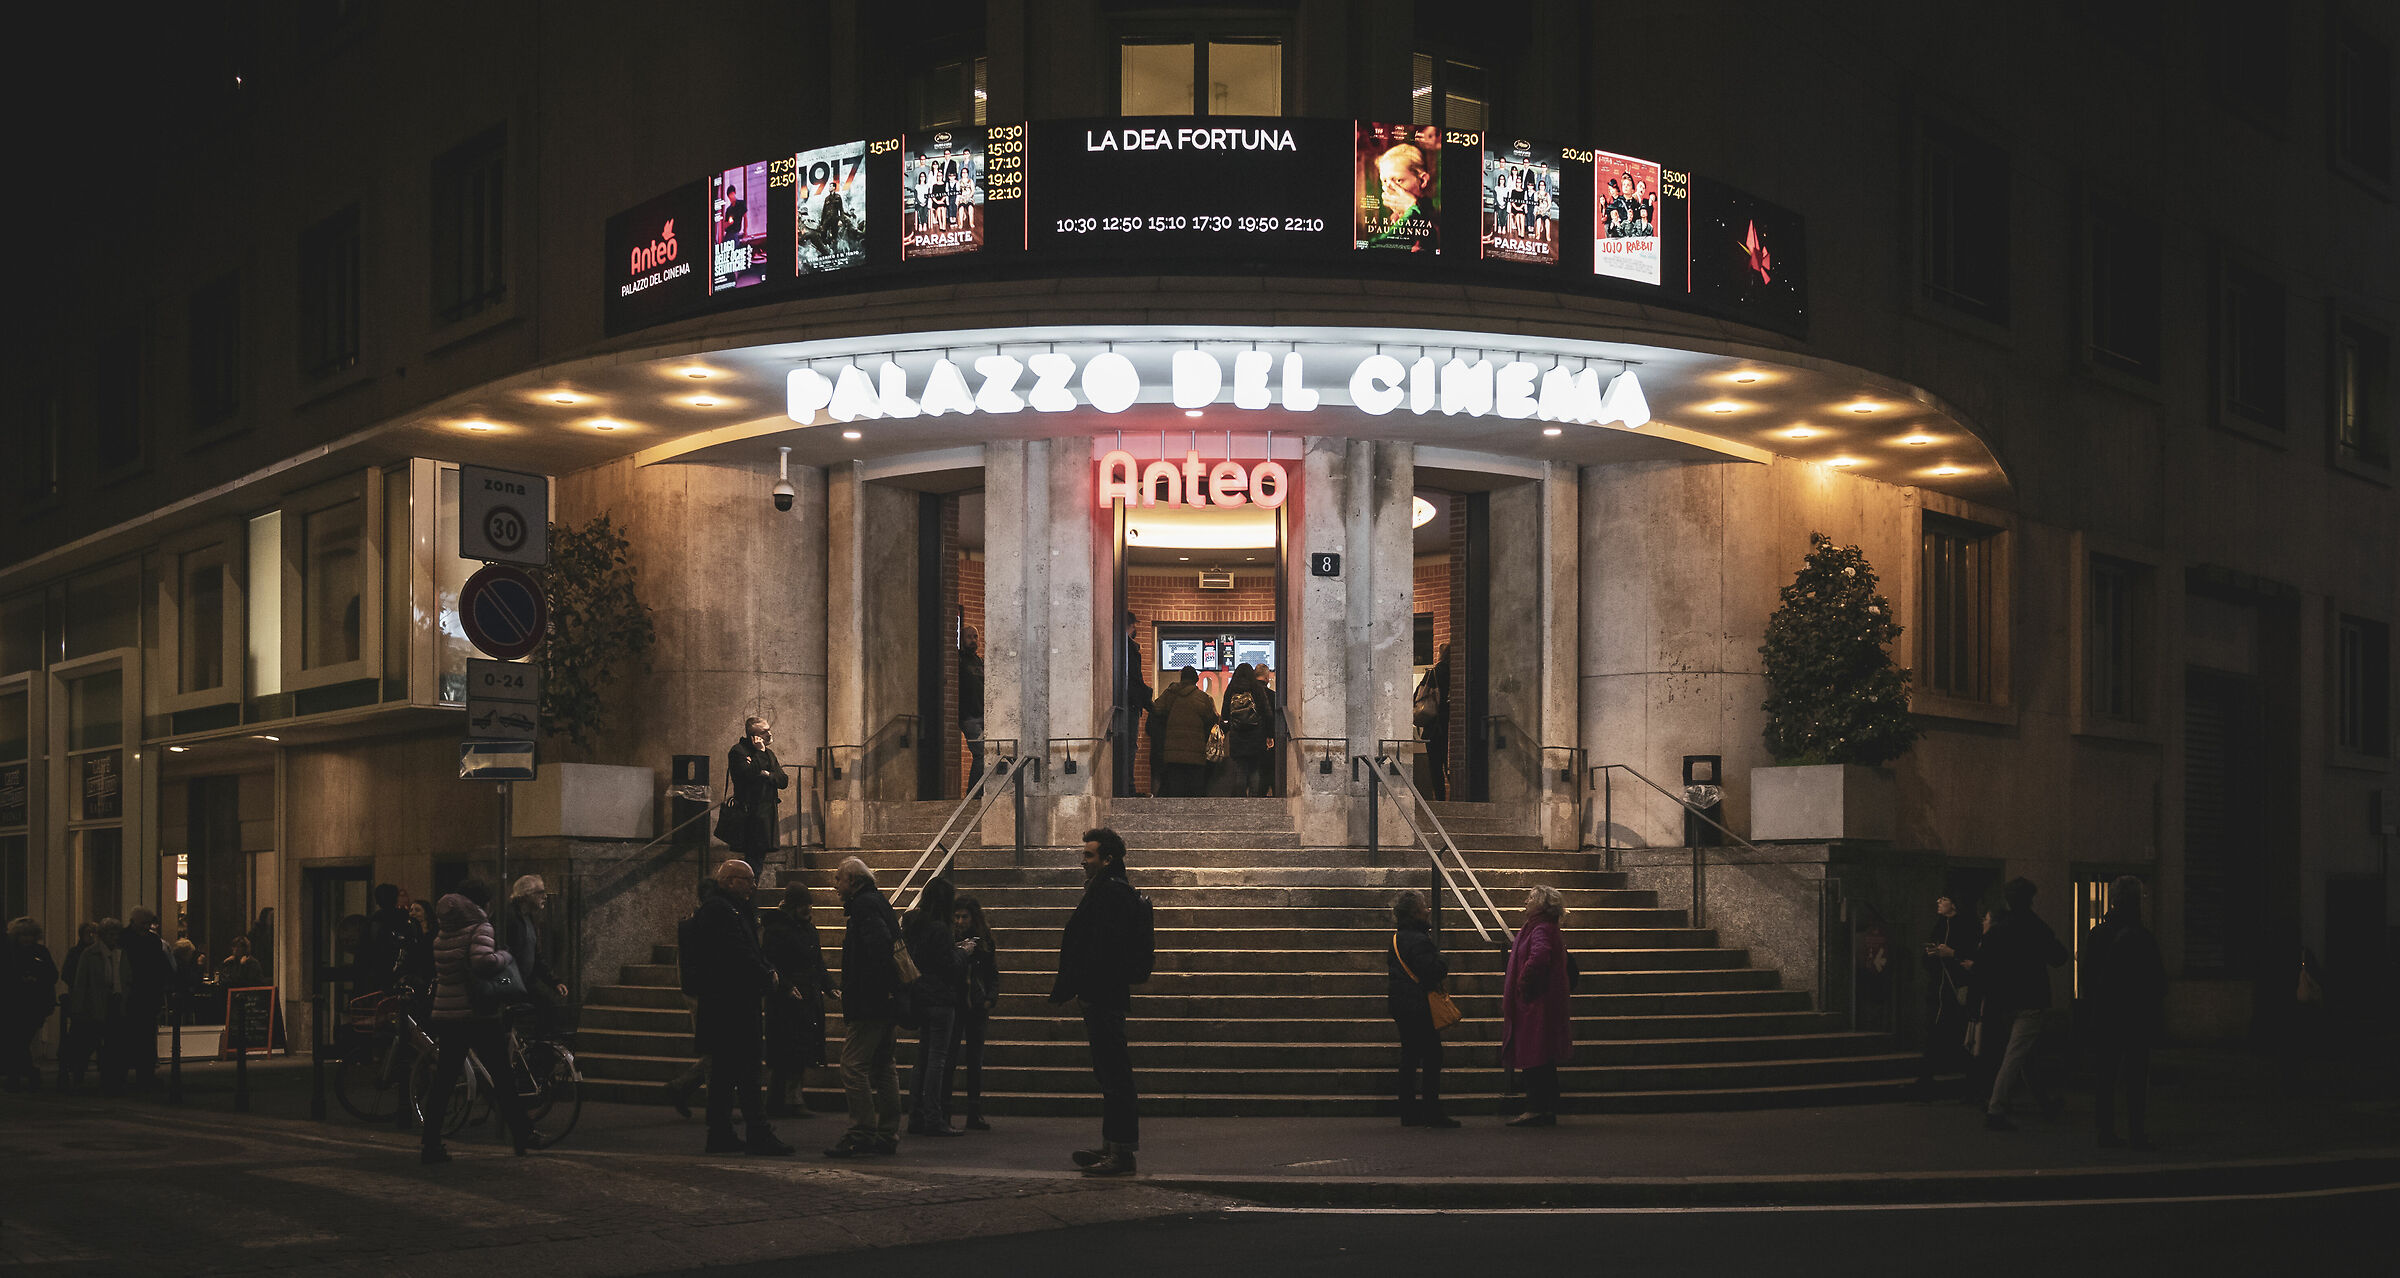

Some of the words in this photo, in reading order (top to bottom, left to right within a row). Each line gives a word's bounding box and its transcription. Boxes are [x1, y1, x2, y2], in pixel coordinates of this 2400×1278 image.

[987, 125, 1022, 140] 10:30
[1087, 129, 1118, 151] LA
[1123, 128, 1173, 151] DEA
[1178, 128, 1297, 151] FORTUNA
[1446, 131, 1479, 147] 12:30
[869, 138, 899, 155] 15:10
[987, 140, 1022, 156] 15:00
[1562, 147, 1593, 163] 20:40
[770, 157, 795, 173] 17:30
[989, 156, 1021, 171] 17:10
[769, 172, 795, 188] 21:50
[798, 154, 865, 199] 1917
[987, 171, 1022, 186] 19:40
[1662, 168, 1687, 185] 15:00
[988, 187, 1021, 200] 22:10
[1662, 183, 1687, 200] 17:40
[1056, 217, 1097, 233] 10:30
[1102, 216, 1142, 232] 12:50
[1148, 216, 1186, 231] 15:10
[1192, 215, 1232, 231] 17:30
[1237, 216, 1279, 232] 19:50
[1284, 217, 1324, 232] 22:10
[1368, 225, 1430, 237] D'AUTUNNO
[1383, 217, 1432, 229] RAGAZZA
[720, 240, 735, 254] LAGO
[915, 231, 973, 247] PARASITE
[1494, 236, 1550, 254] PARASITE
[1601, 242, 1622, 254] JOJO
[1626, 240, 1653, 254] RABBIT
[631, 238, 678, 276] Anteo
[621, 275, 649, 297] PALAZZO
[649, 272, 663, 287] DEL
[663, 263, 691, 282] CINEMA
[787, 352, 1140, 425] PALAZZO
[1172, 349, 1320, 411] DEL
[1349, 354, 1651, 428] CINEMA
[484, 479, 526, 495] zona
[1099, 449, 1288, 509] Anteo
[493, 518, 518, 540] 30
[1322, 556, 1332, 572] 8
[484, 673, 524, 688] 0-24
